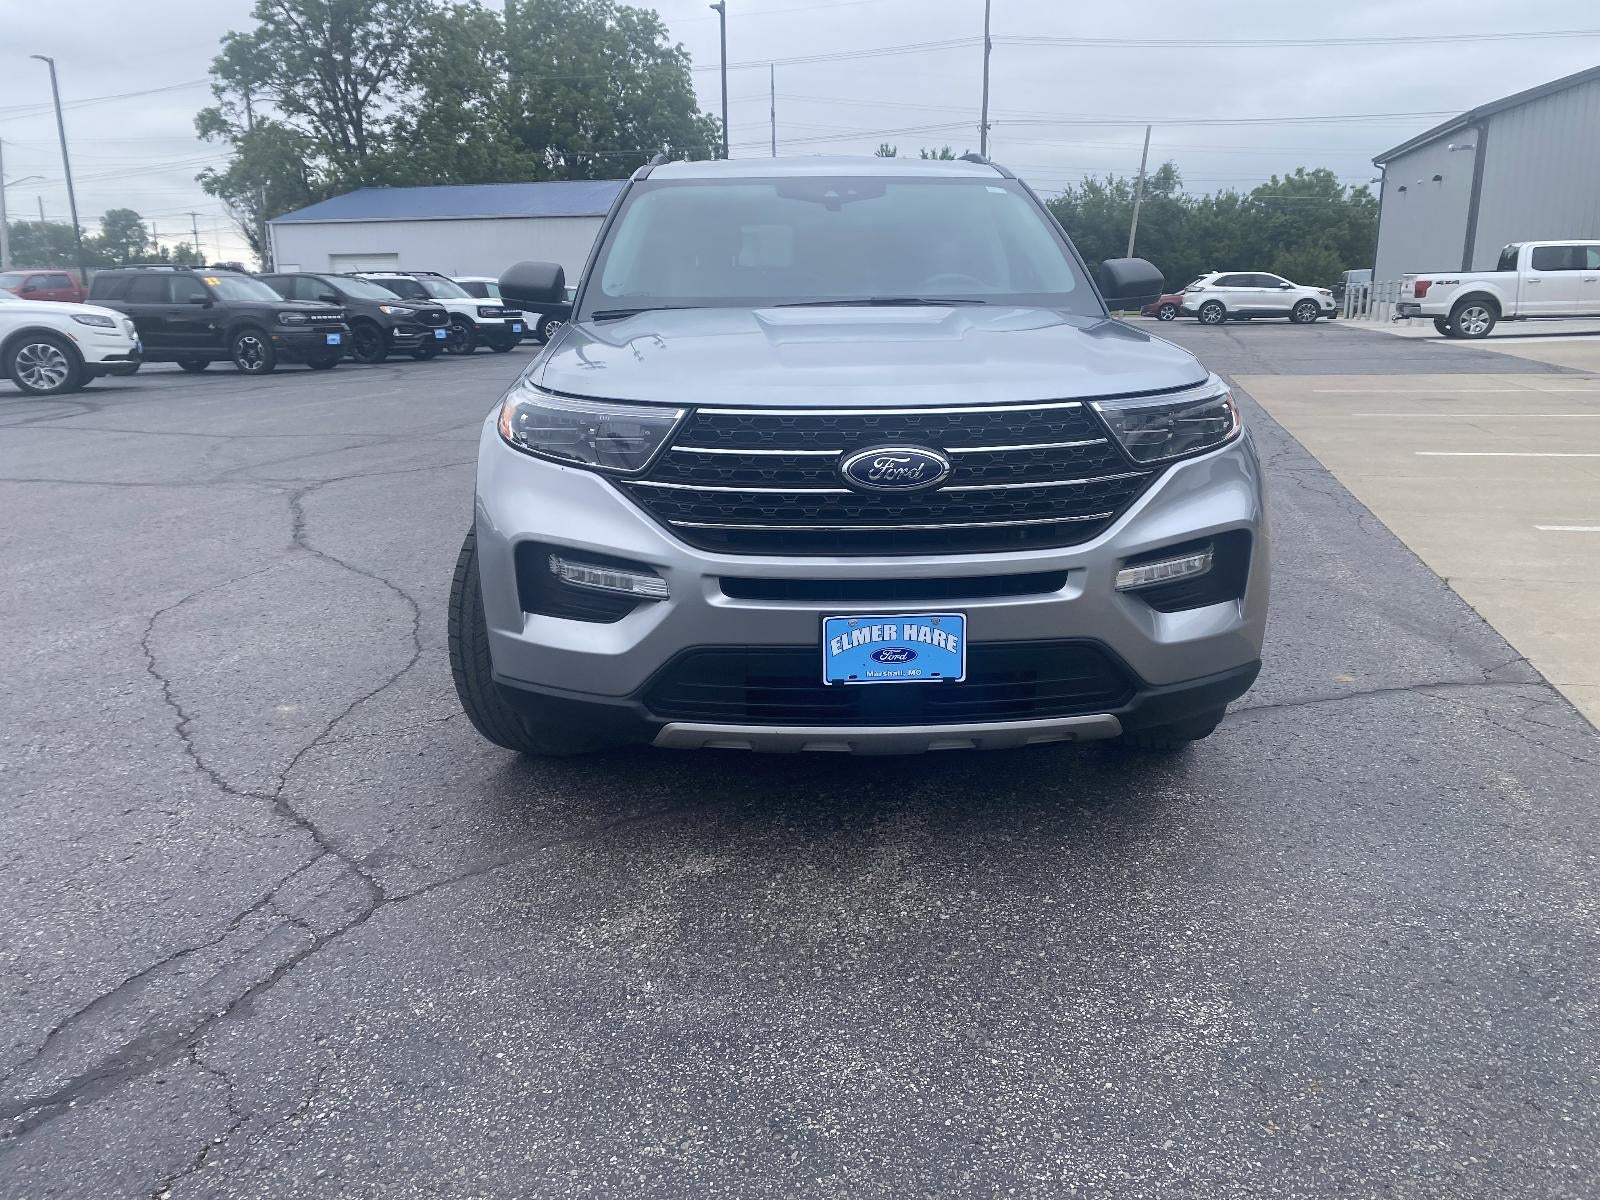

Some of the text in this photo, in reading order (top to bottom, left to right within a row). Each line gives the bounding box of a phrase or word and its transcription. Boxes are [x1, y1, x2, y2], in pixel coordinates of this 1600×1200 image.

[868, 457, 925, 480] Ford
[830, 624, 959, 657] ELMER HARE
[879, 649, 908, 661] Ford
[908, 668, 922, 676] MO
